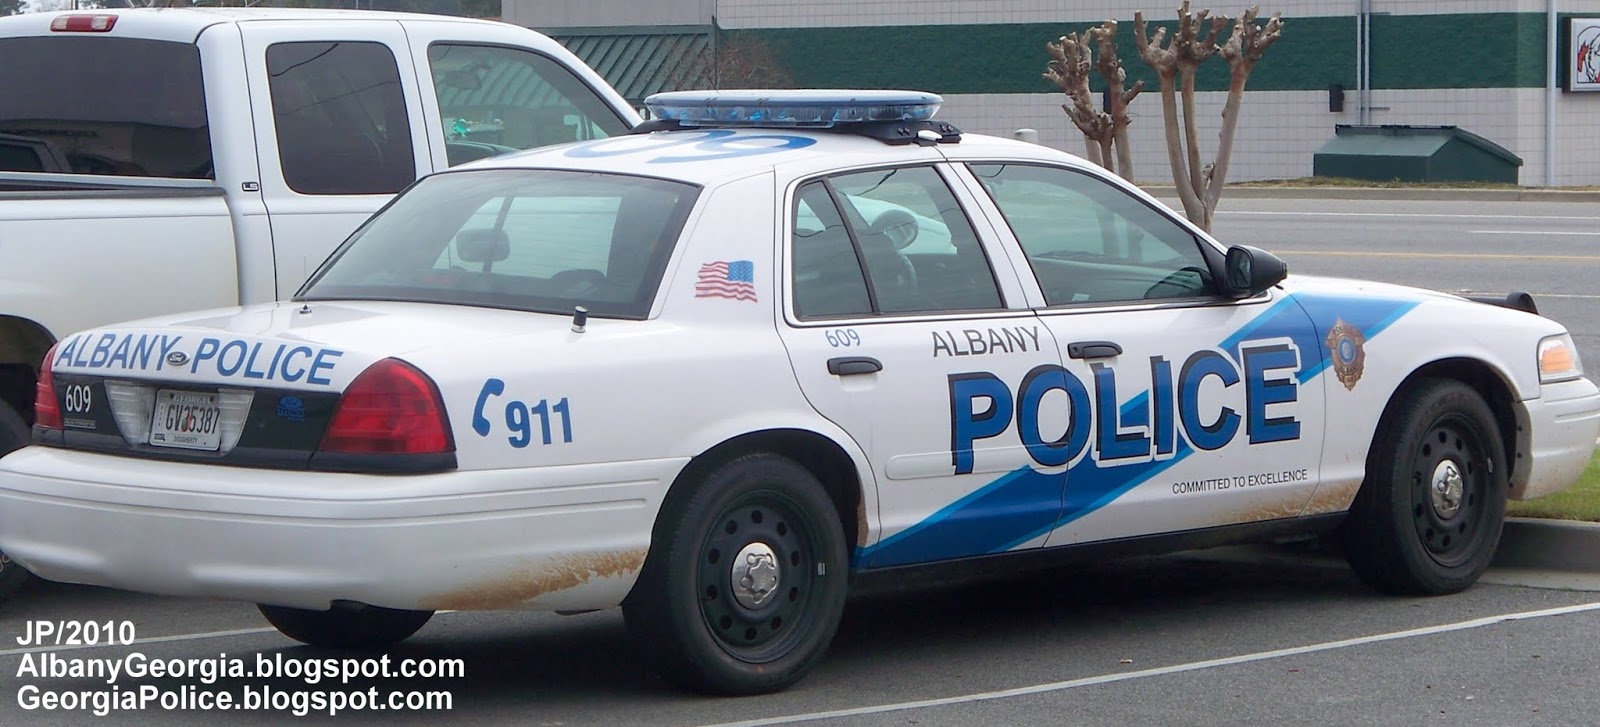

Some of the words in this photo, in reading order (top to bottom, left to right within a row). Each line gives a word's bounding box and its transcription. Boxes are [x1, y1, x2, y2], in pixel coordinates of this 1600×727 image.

[242, 182, 259, 191] LS
[825, 328, 861, 347] 609
[931, 325, 1041, 357] ALBANY
[54, 334, 182, 371] ALBANY
[190, 338, 344, 386] POLICE
[65, 384, 92, 413] 609
[946, 338, 1303, 476] POLICE
[505, 397, 573, 449] 911
[1172, 477, 1230, 494] COMMITTED
[1233, 476, 1246, 488] TO
[1248, 468, 1308, 487] EXCELLENCE
